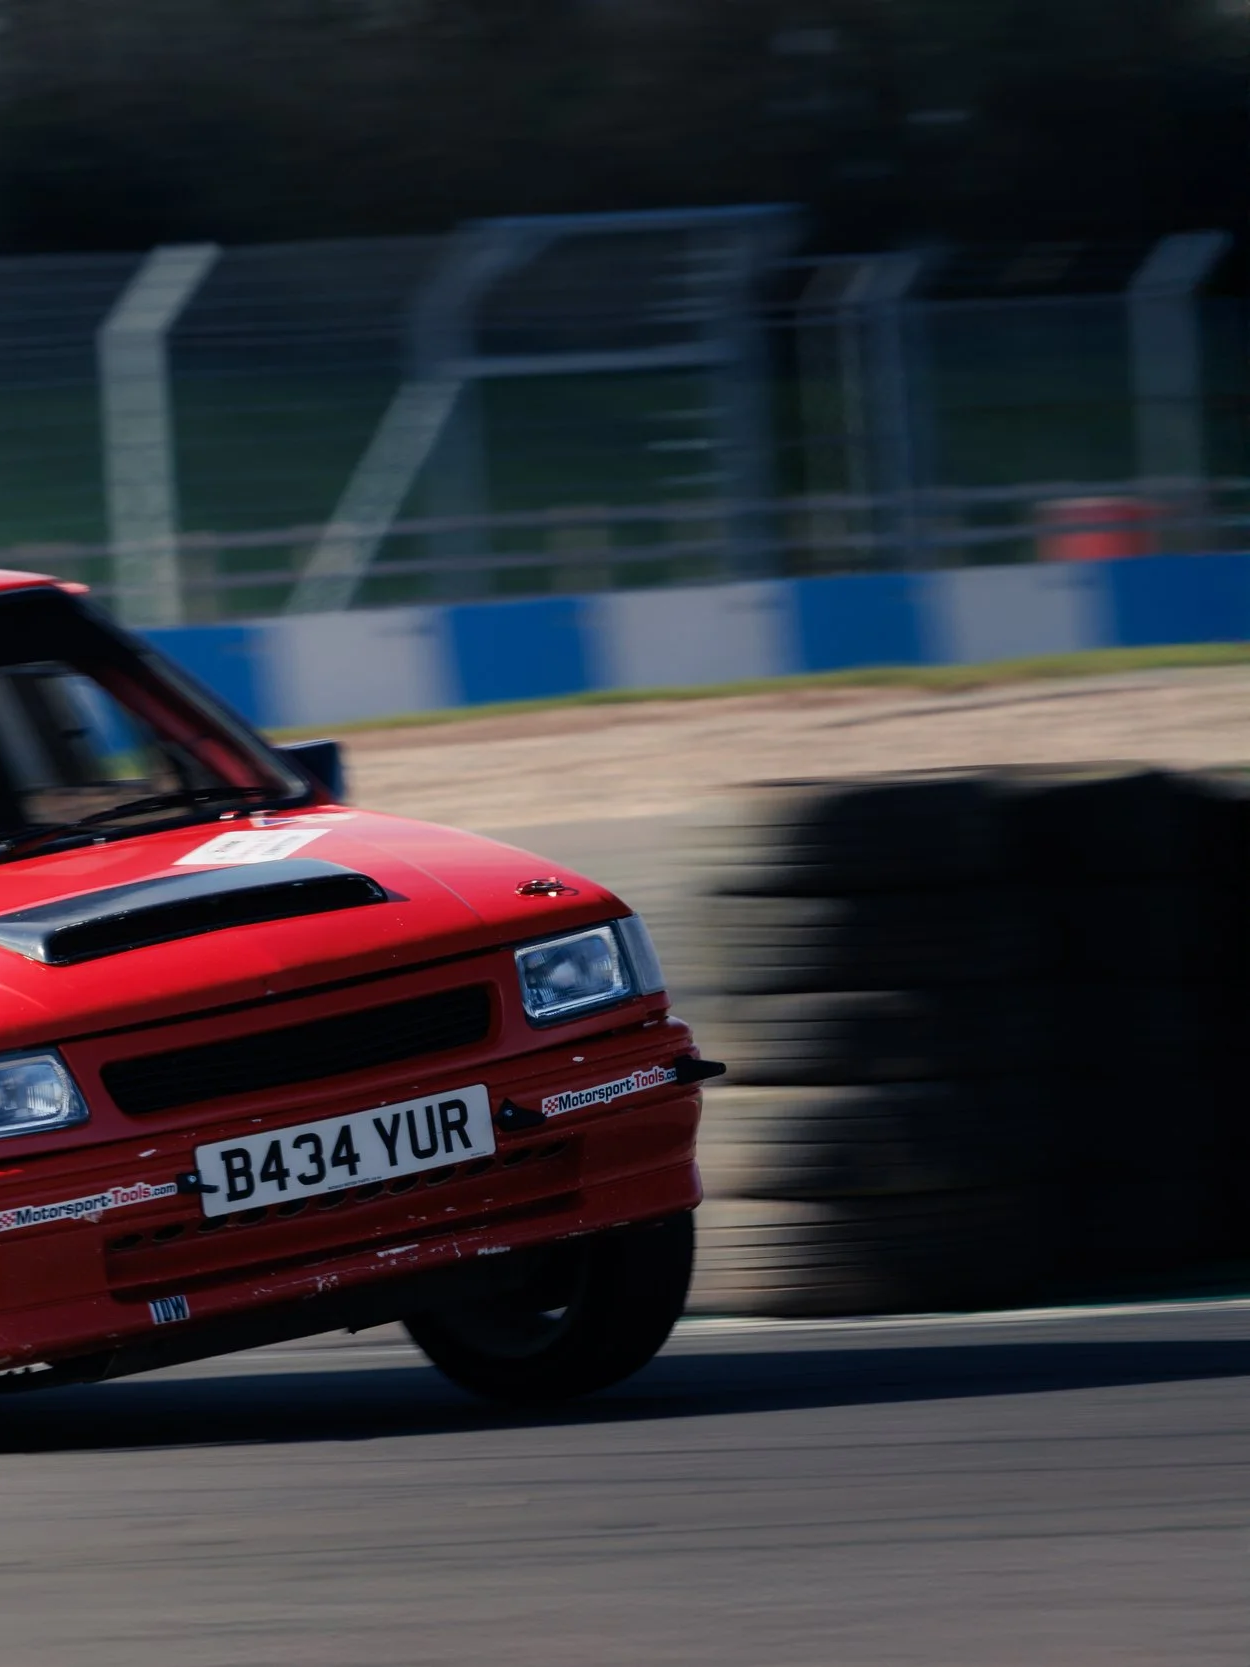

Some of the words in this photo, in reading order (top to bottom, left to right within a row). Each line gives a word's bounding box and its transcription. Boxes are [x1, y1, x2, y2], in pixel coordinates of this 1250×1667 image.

[557, 1068, 677, 1112] Motorsport-Tools.co
[220, 1124, 362, 1202] B434
[372, 1098, 473, 1167] YUR
[15, 1183, 177, 1226] Motorsport-Tools.com
[149, 1295, 187, 1323] TOW
